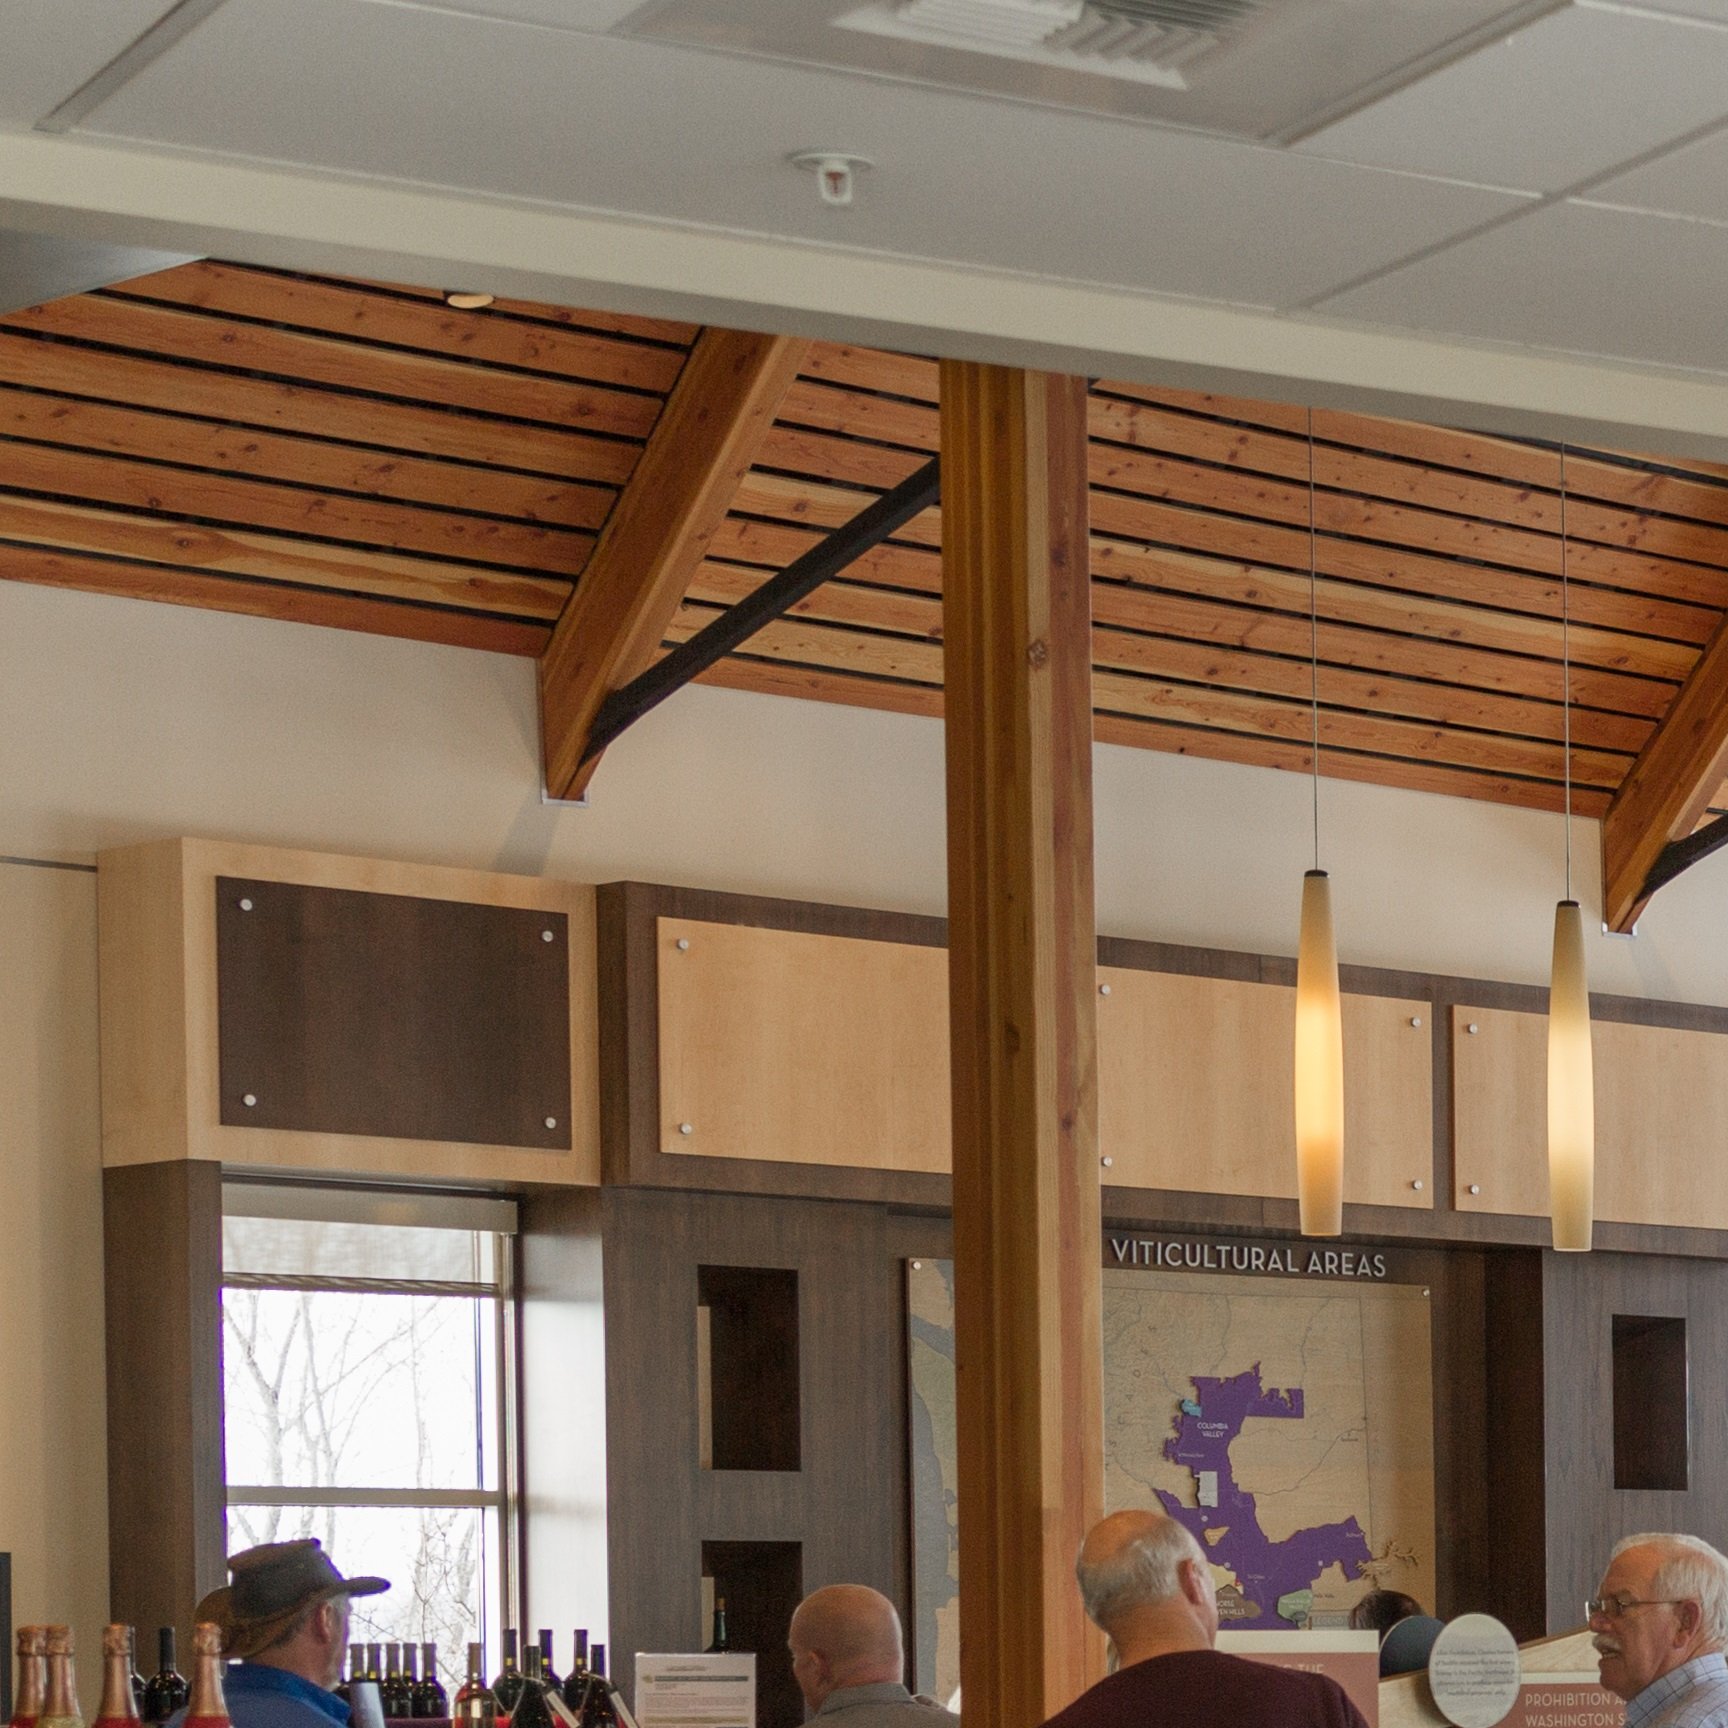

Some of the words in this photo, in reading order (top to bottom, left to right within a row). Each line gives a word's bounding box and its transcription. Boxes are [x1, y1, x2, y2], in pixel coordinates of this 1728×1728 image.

[1111, 1238, 1300, 1273] VITICULTURAL
[1306, 1250, 1387, 1278] AREAS
[1525, 1692, 1611, 1707] PROHIBITION
[1525, 1712, 1614, 1727] WASHINGTON
